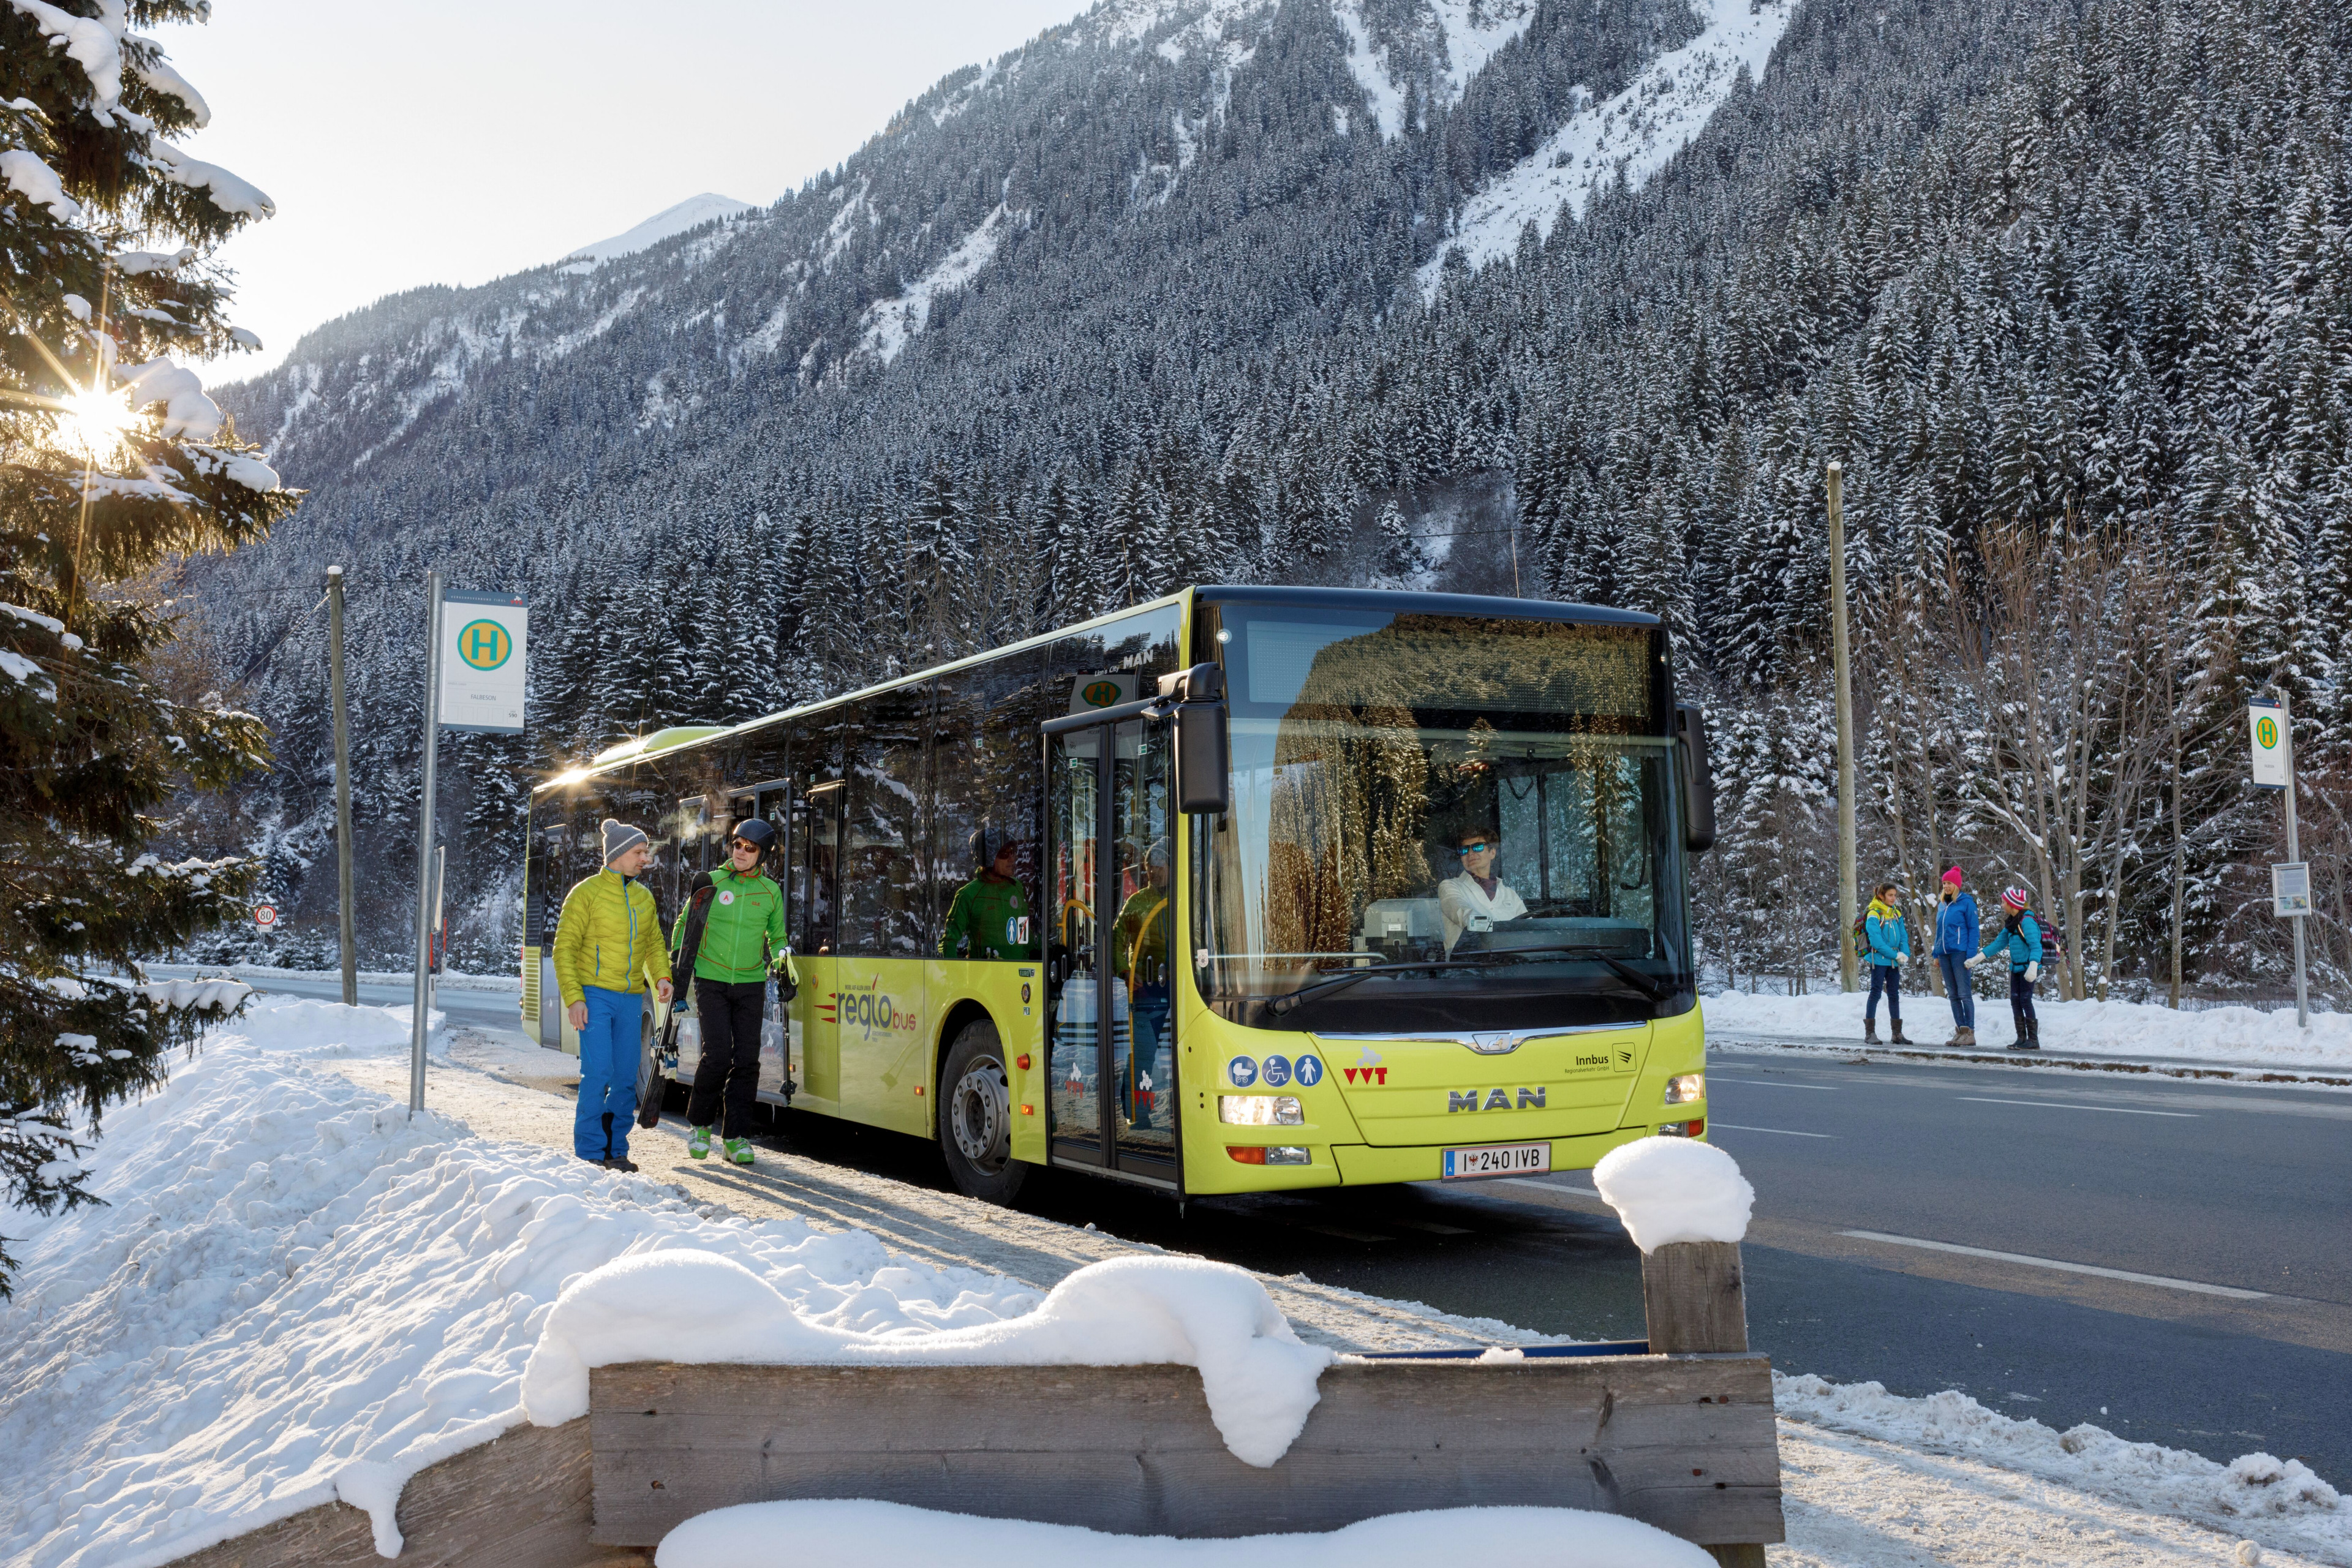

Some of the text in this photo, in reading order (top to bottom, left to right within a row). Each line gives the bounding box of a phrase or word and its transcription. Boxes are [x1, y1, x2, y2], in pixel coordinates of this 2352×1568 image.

[471, 629, 498, 662] H
[1095, 668, 1108, 677] Lion's
[1123, 649, 1154, 669] MAN
[2262, 723, 2272, 743] H
[260, 911, 271, 919] 80
[1576, 1054, 1609, 1066] Innbus
[1343, 1067, 1387, 1086] VVT
[1448, 1087, 1545, 1112] MAN
[1481, 1151, 1510, 1170] 240
[1515, 1149, 1539, 1168] IVB
